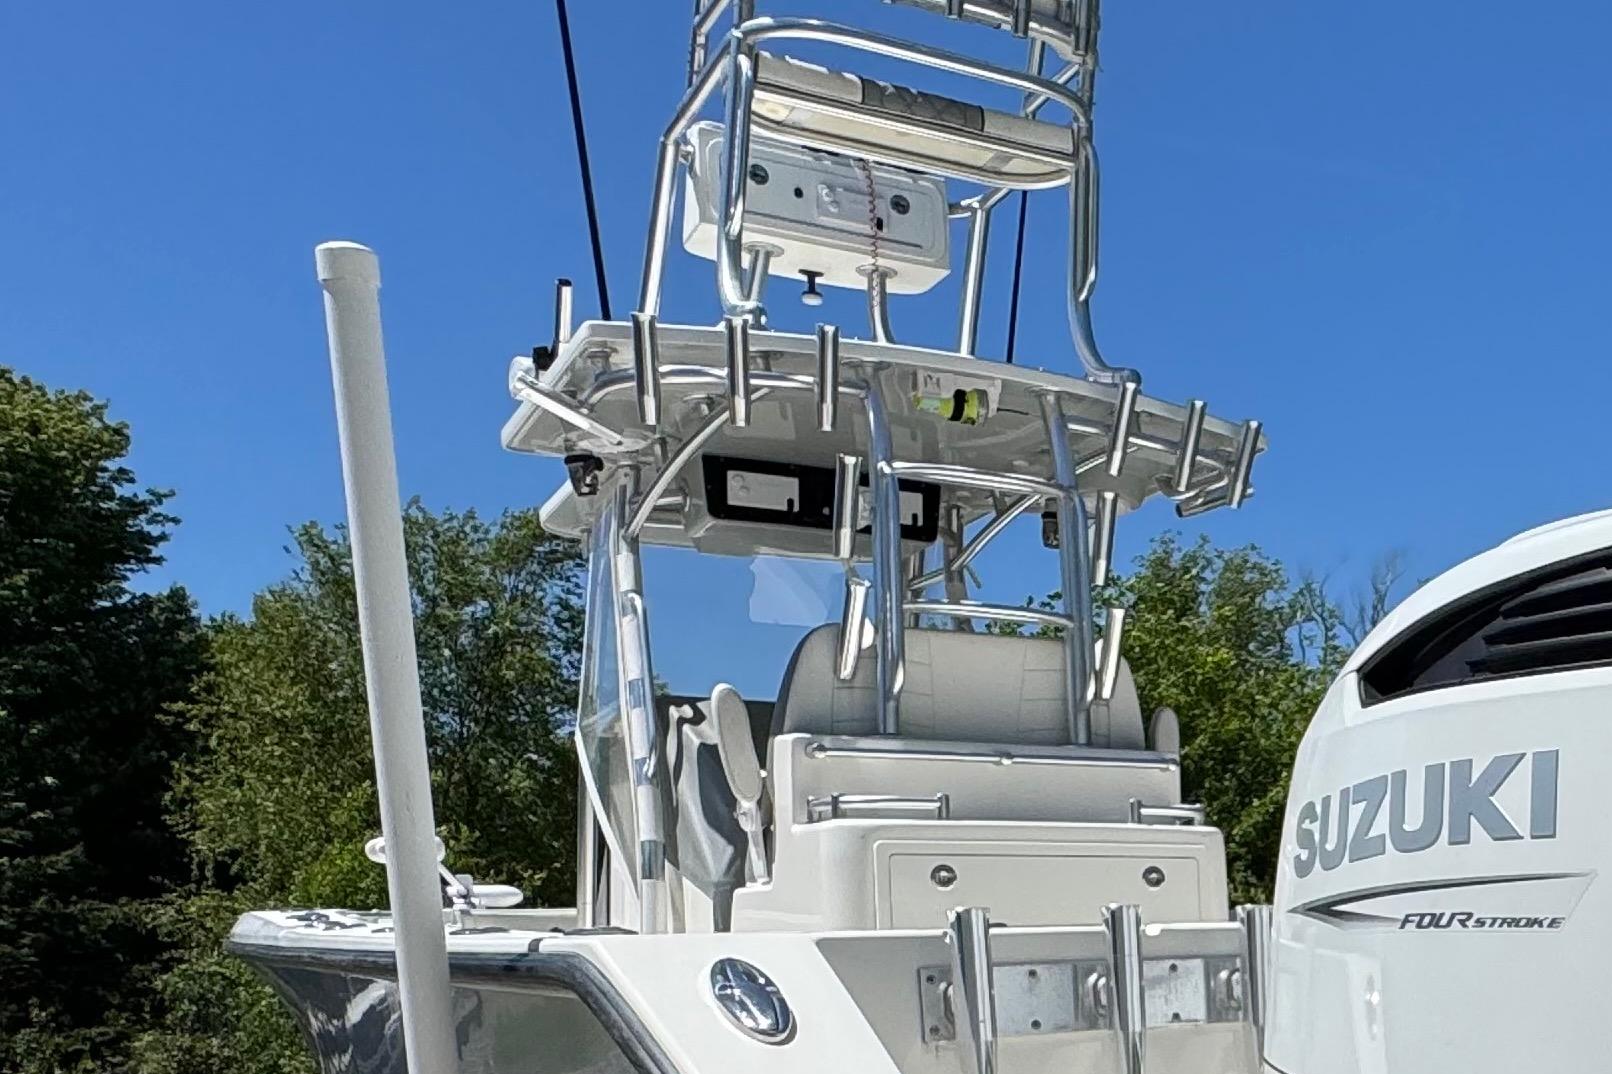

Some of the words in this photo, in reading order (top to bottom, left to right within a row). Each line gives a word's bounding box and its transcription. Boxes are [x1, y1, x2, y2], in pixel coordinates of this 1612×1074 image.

[1293, 749, 1559, 880] SUZUKI
[1399, 911, 1473, 929] FOUR
[1471, 917, 1566, 929] STROKE
